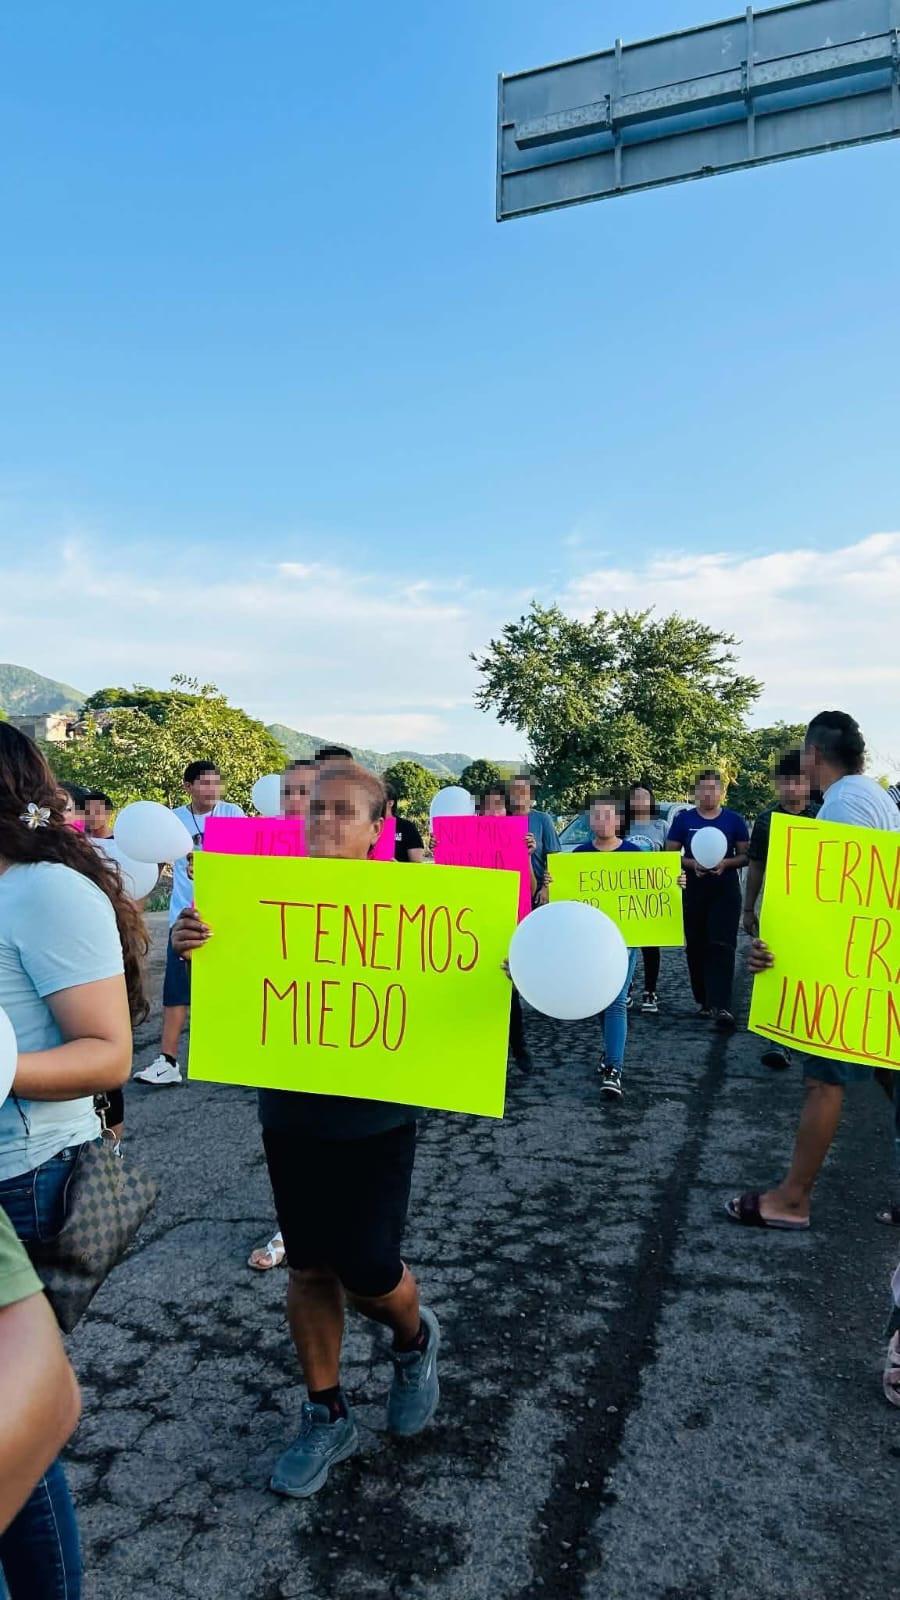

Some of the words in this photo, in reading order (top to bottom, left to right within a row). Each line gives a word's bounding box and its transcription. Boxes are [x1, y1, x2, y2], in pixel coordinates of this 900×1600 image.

[255, 829, 304, 856] JUST
[786, 826, 900, 911] FERN
[579, 866, 673, 893] ESCUCHENOS
[618, 891, 672, 920] FAVOR
[259, 900, 479, 973] TENEMOS
[845, 916, 900, 984] ER
[261, 977, 407, 1051] MIEDO
